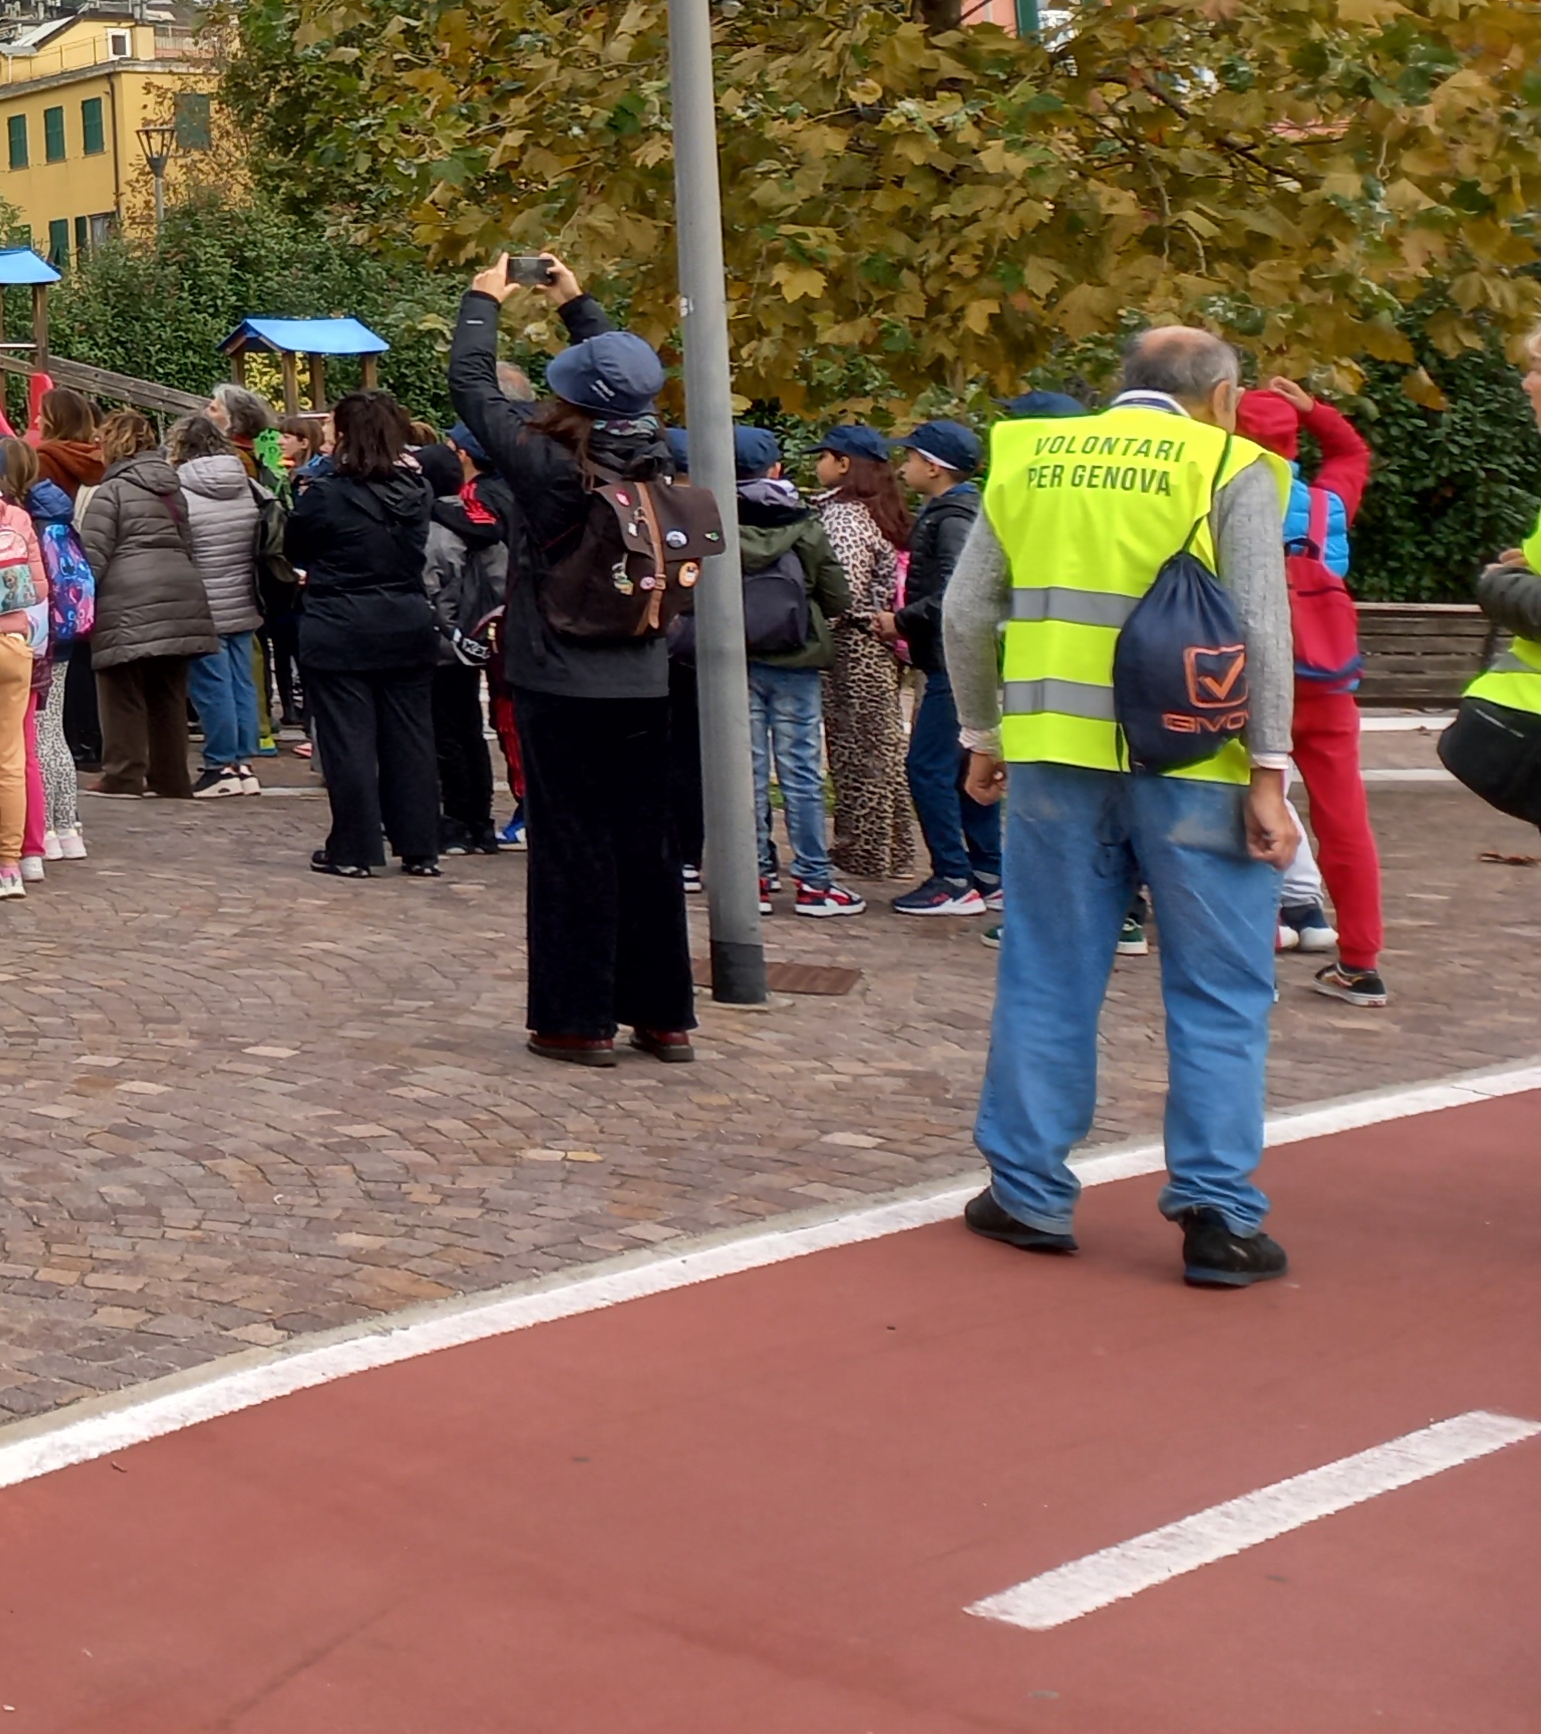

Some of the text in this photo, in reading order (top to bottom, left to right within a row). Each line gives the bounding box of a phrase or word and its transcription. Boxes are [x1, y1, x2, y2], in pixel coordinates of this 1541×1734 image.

[1034, 435, 1186, 463] VOLONTARI
[1027, 464, 1172, 497] PER GENOVA
[1161, 709, 1249, 734] GIVO
